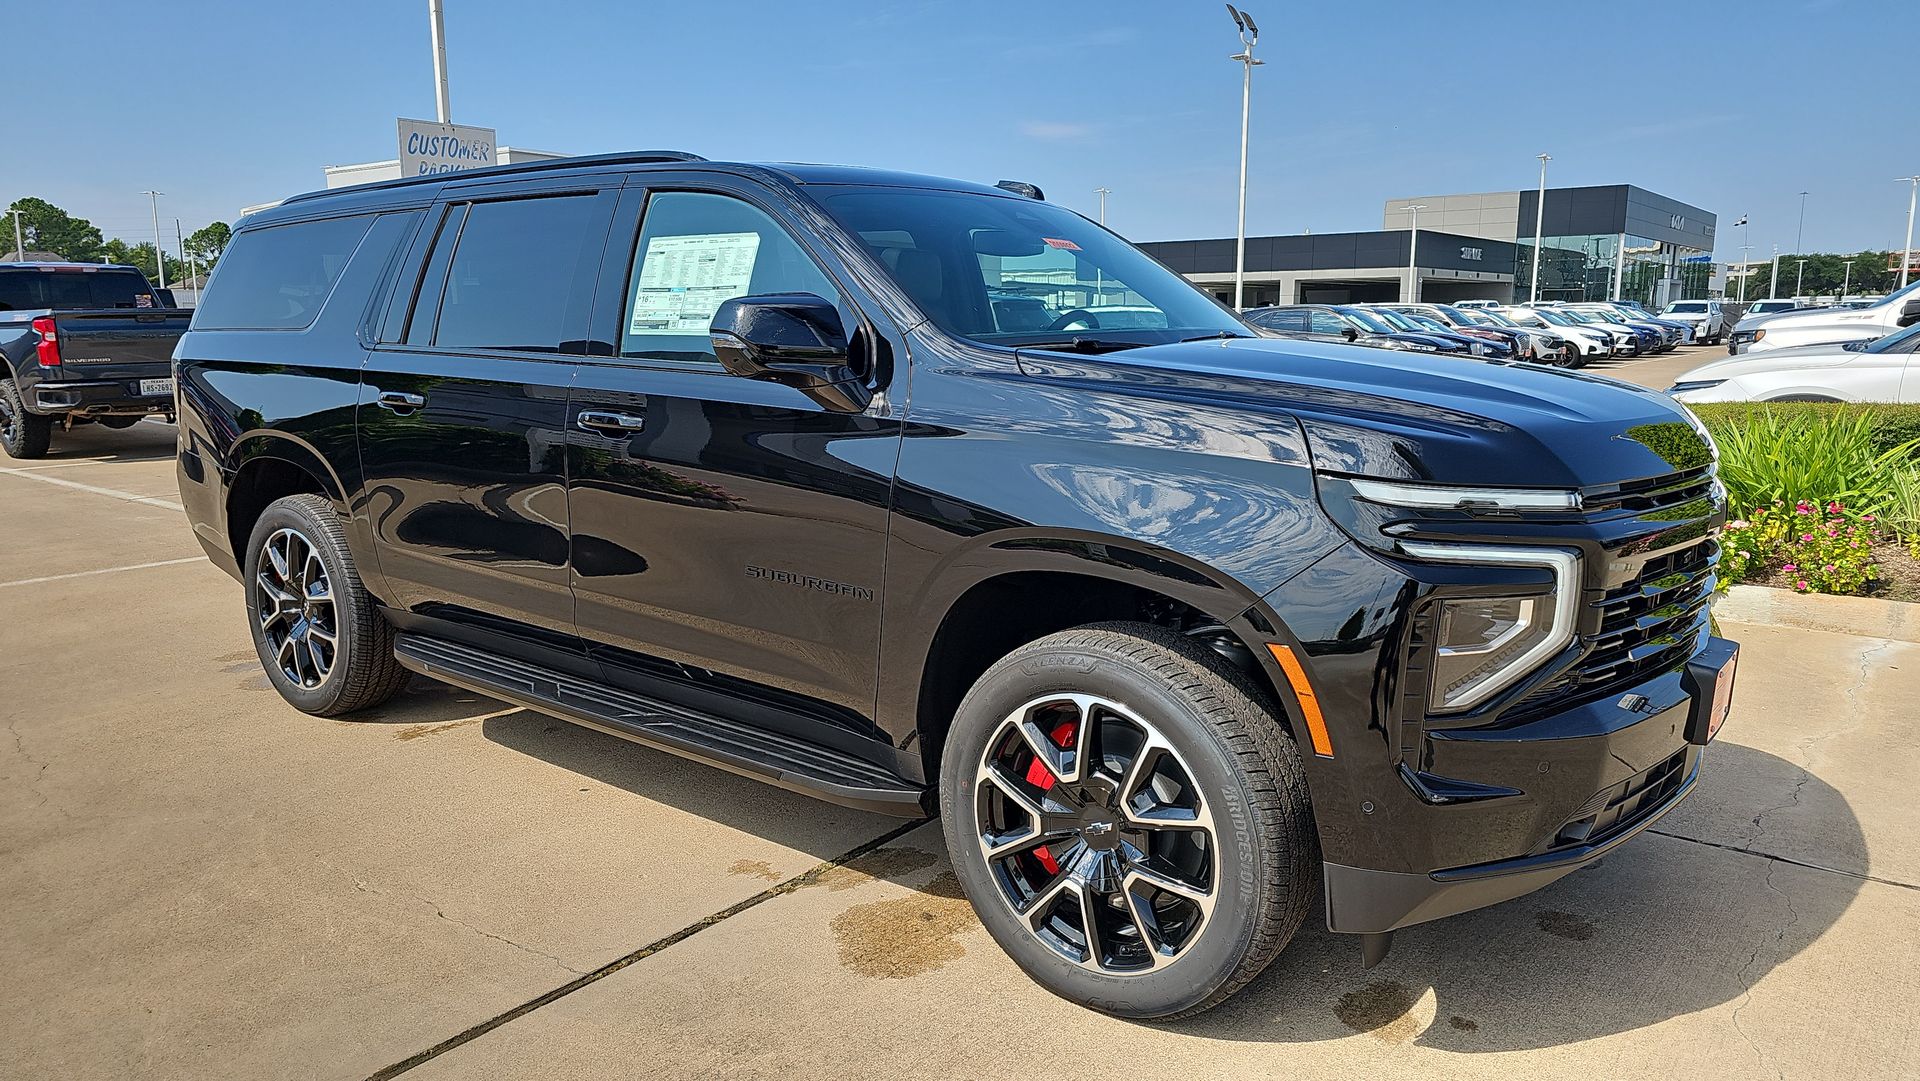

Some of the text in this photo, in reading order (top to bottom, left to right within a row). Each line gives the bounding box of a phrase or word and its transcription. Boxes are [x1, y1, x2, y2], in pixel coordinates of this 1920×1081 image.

[408, 132, 490, 161] CUSTOMER
[745, 564, 875, 602] SUBURBAN
[1031, 656, 1087, 668] ALENZA
[1221, 784, 1254, 905] BRIDGESTONE
